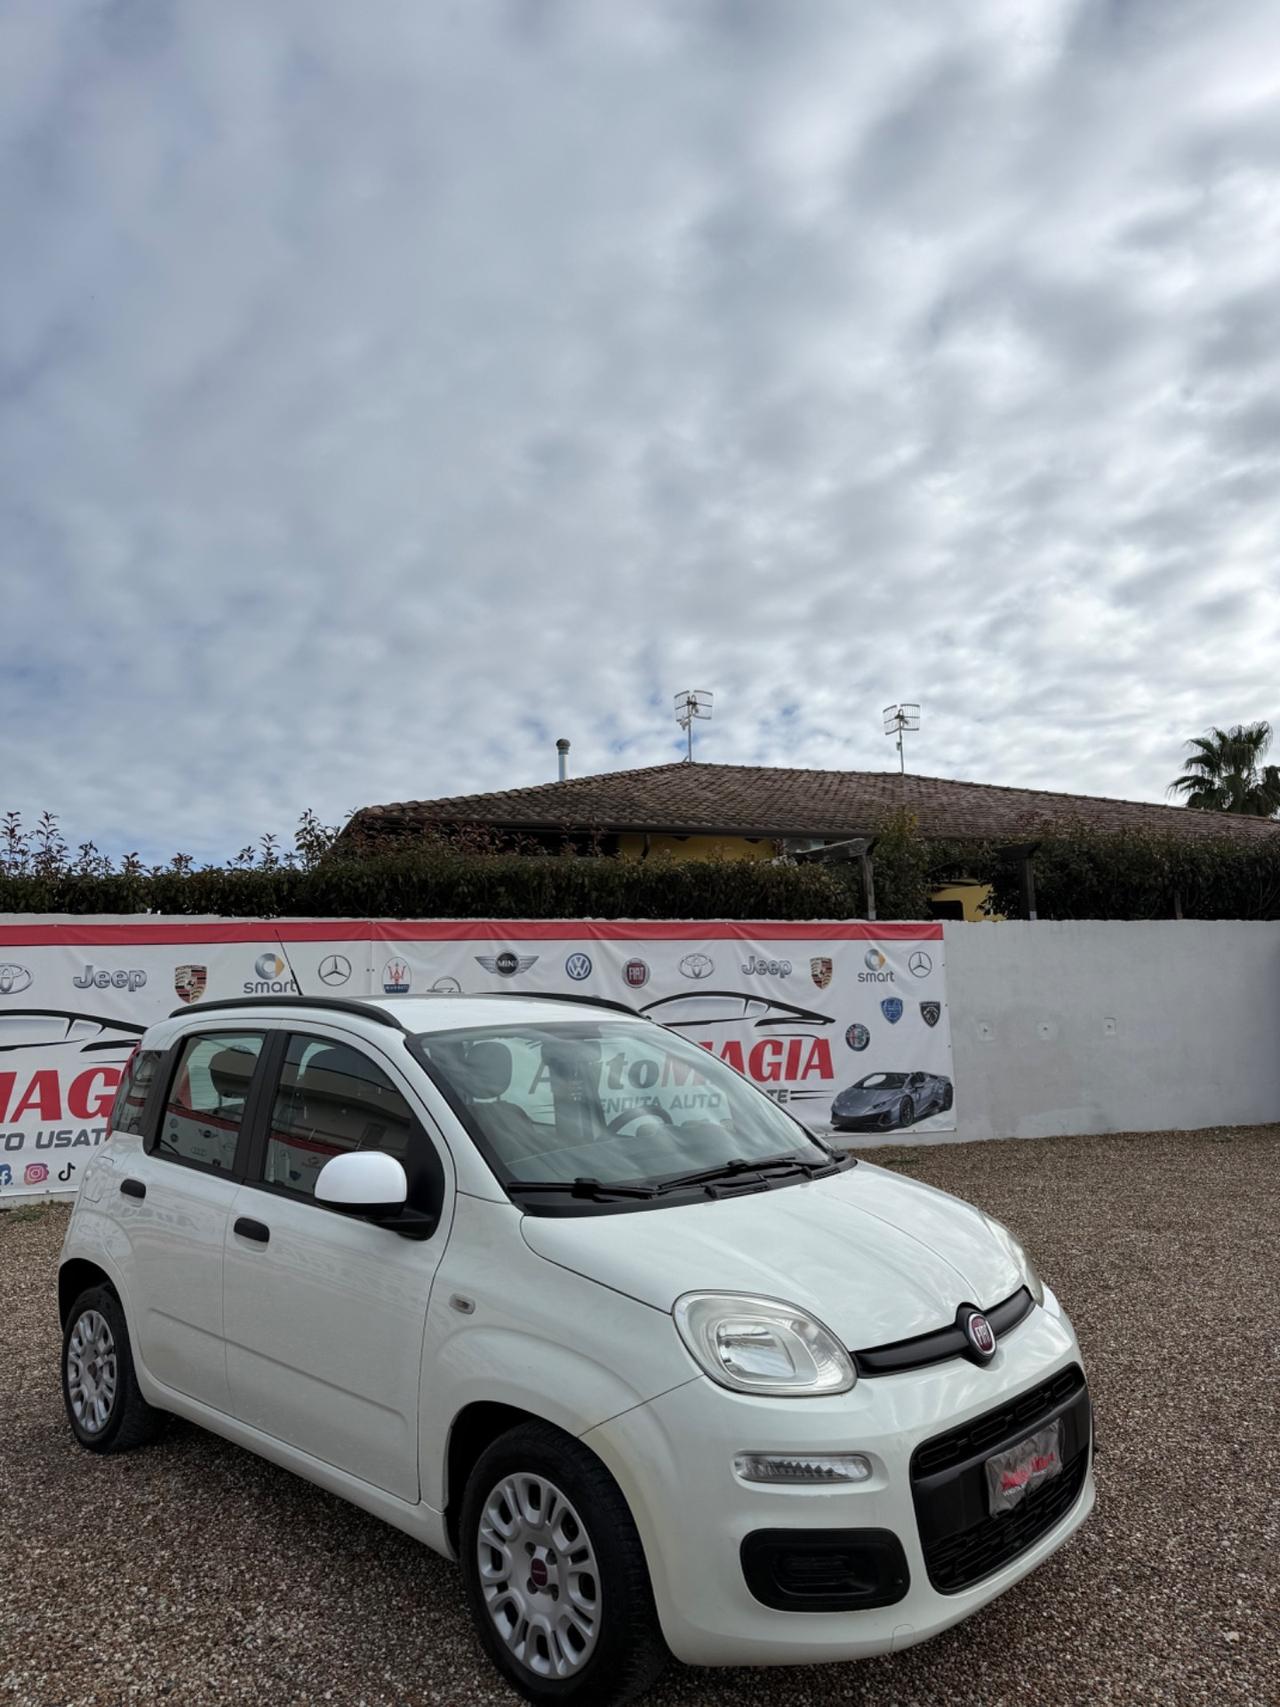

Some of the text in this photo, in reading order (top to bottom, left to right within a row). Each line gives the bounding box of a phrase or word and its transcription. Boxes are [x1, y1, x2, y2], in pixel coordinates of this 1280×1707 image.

[741, 956, 792, 979] Jeep
[857, 970, 895, 983] smart
[73, 965, 147, 991] Jeep
[243, 980, 297, 994] smart
[669, 1092, 721, 1110] AUTO
